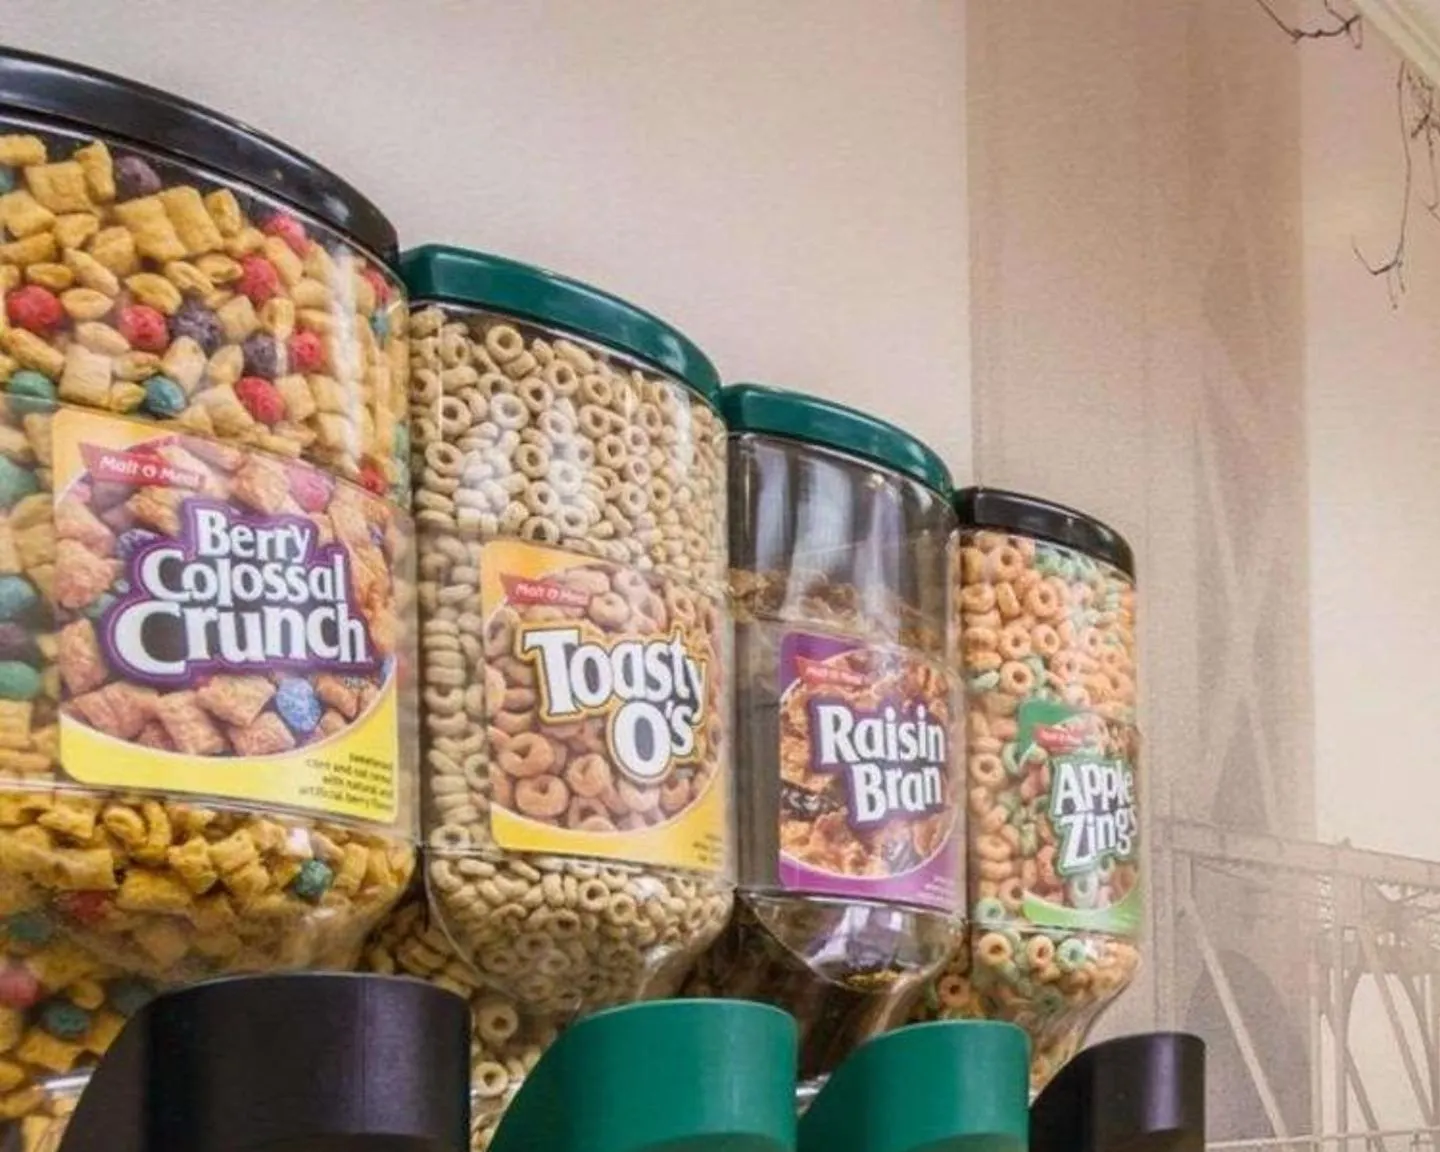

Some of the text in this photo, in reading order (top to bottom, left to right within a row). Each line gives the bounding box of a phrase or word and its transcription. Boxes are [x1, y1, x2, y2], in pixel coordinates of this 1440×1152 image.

[196, 508, 310, 562] Berry
[142, 549, 345, 606] Colossal
[115, 600, 368, 674] Crunch
[524, 628, 706, 723] Toasty
[613, 699, 694, 777] O's
[817, 704, 946, 764] Raisin
[852, 762, 942, 823] Bran
[1054, 760, 1135, 815] Apple
